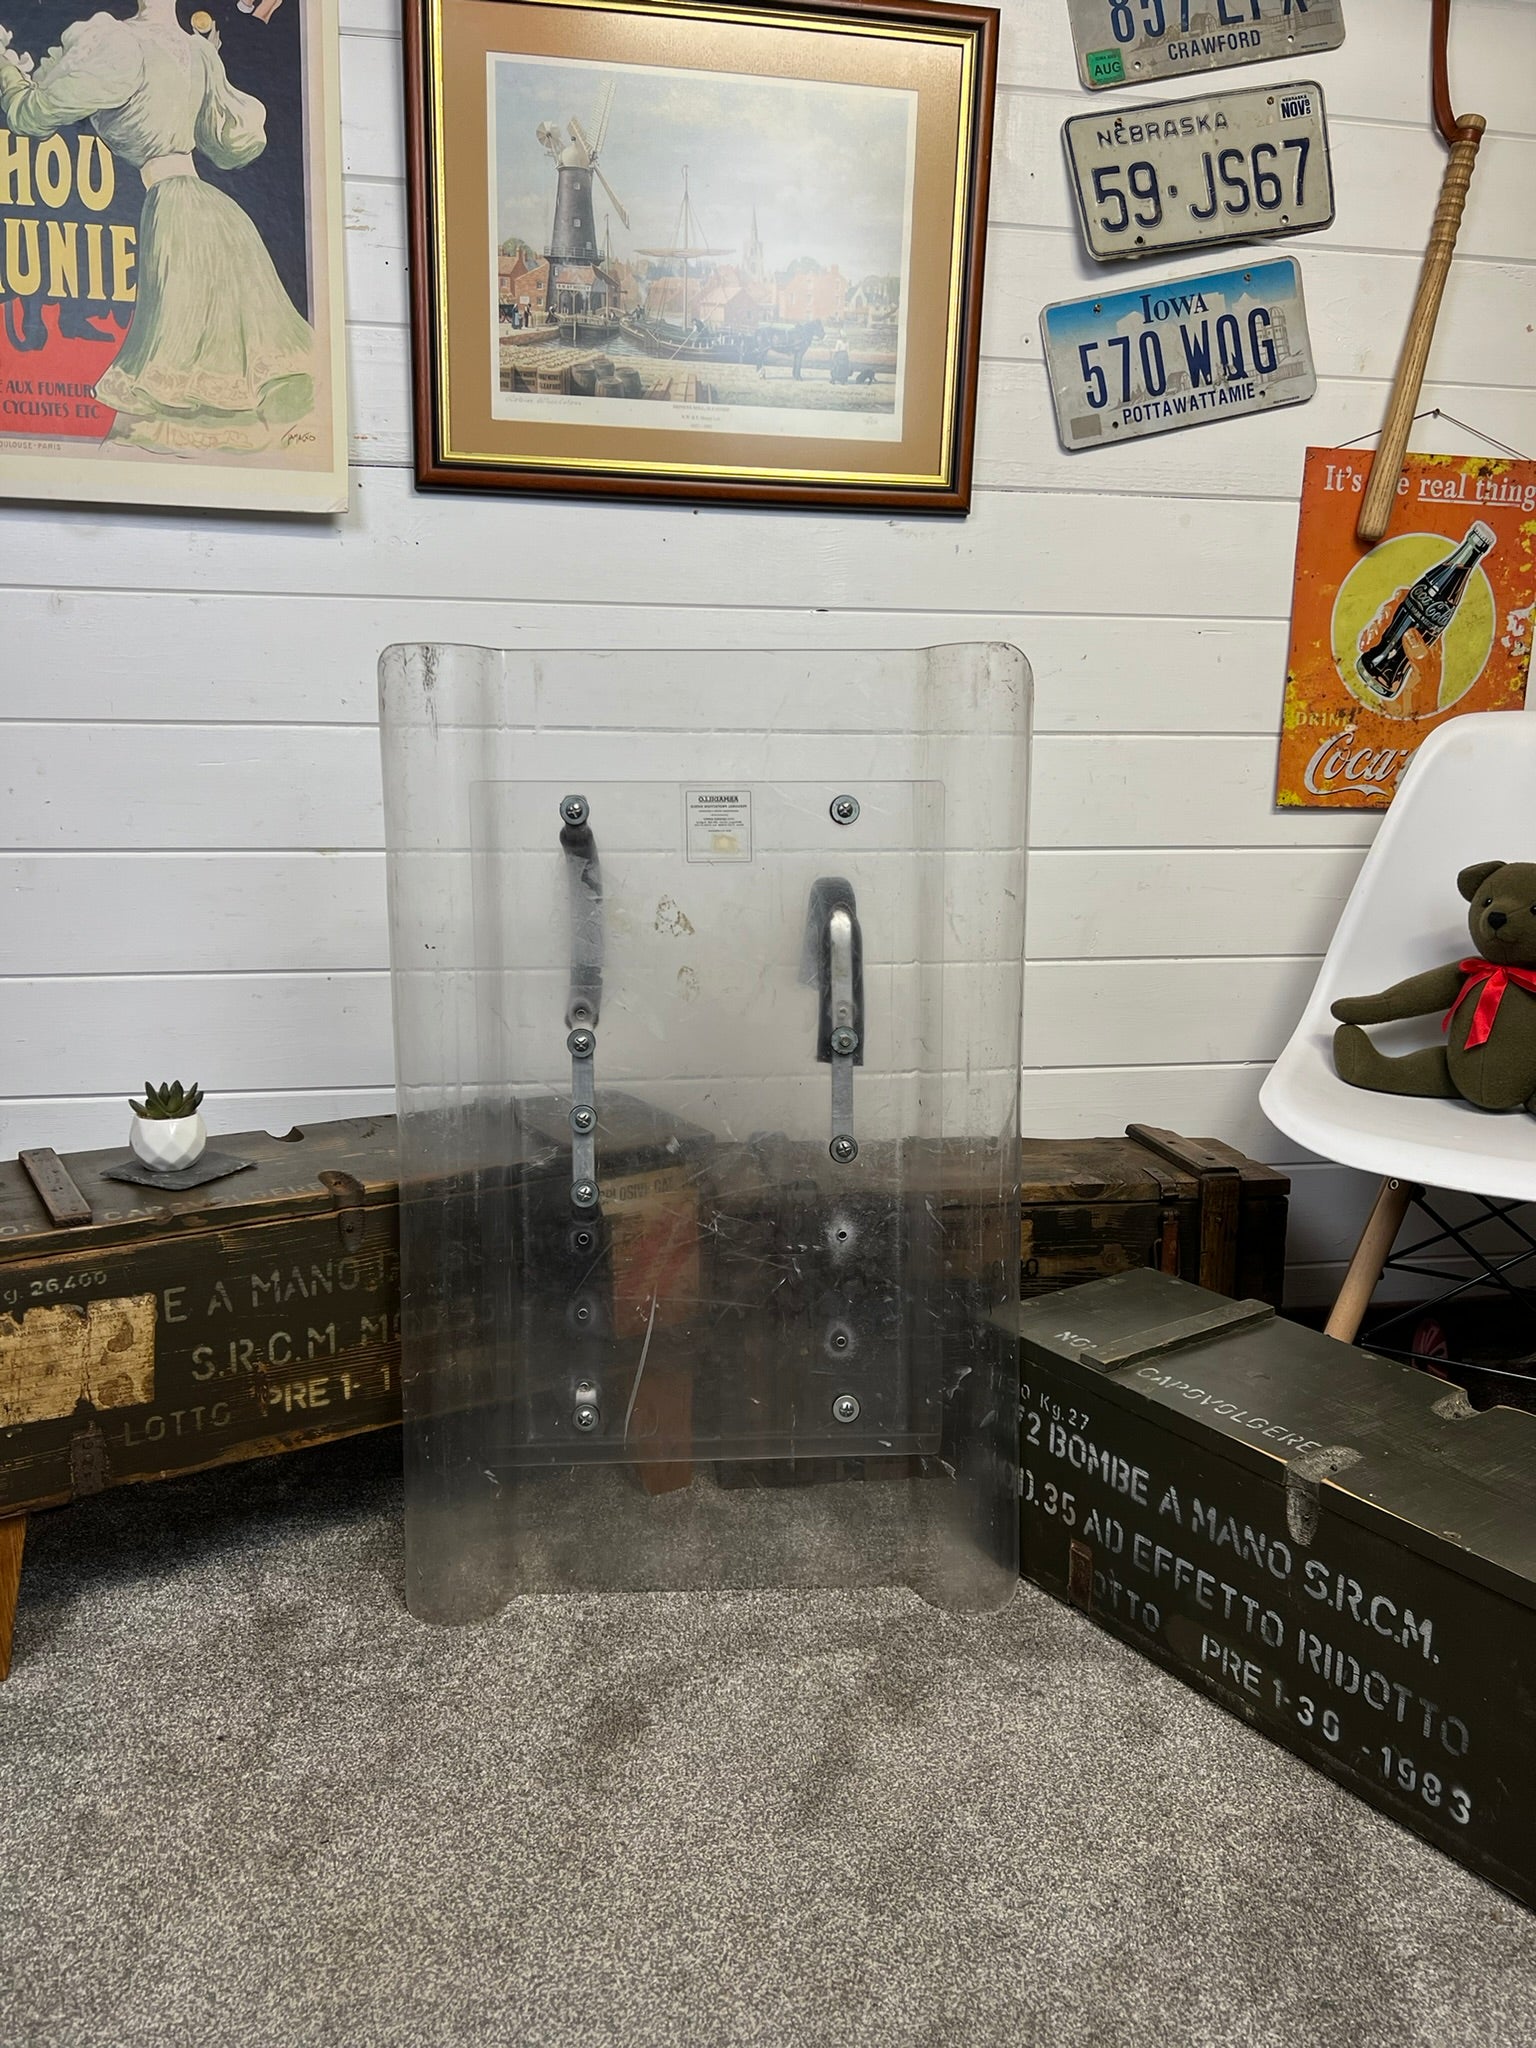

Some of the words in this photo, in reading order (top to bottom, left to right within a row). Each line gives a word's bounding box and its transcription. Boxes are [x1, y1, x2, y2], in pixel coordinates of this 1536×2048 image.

[1168, 30, 1261, 60] CRAWFORD
[1095, 61, 1121, 77] AUG
[1096, 112, 1229, 149] NEBRASKA
[1281, 100, 1305, 118] NOV
[0, 218, 137, 302] UNIE
[1078, 330, 1167, 409] 570
[1179, 307, 1278, 389] WQG
[3, 400, 69, 418] CYCLISTES
[75, 404, 100, 419] ETC
[6, 380, 34, 395] AUX
[1122, 382, 1256, 425] POTTAWATTAMIE
[1323, 464, 1363, 493] It's
[1418, 473, 1468, 500] real
[1476, 474, 1536, 512] thing
[207, 1280, 234, 1316] A
[252, 1257, 360, 1308] MANO
[123, 1402, 231, 1447] LOTTO
[1136, 1367, 1323, 1453] CAPOVOLGERE
[1049, 1422, 1150, 1506] BOMBE
[1158, 1485, 1183, 1525] A
[1191, 1498, 1292, 1580] MANO
[1304, 1560, 1440, 1664] S.R.C.M.
[1083, 1508, 1124, 1554] AD
[1133, 1533, 1285, 1648] EFFETTO
[1297, 1628, 1470, 1757] RIDOTTO
[1094, 1568, 1160, 1633] OTTO
[1201, 1634, 1272, 1698] PRE
